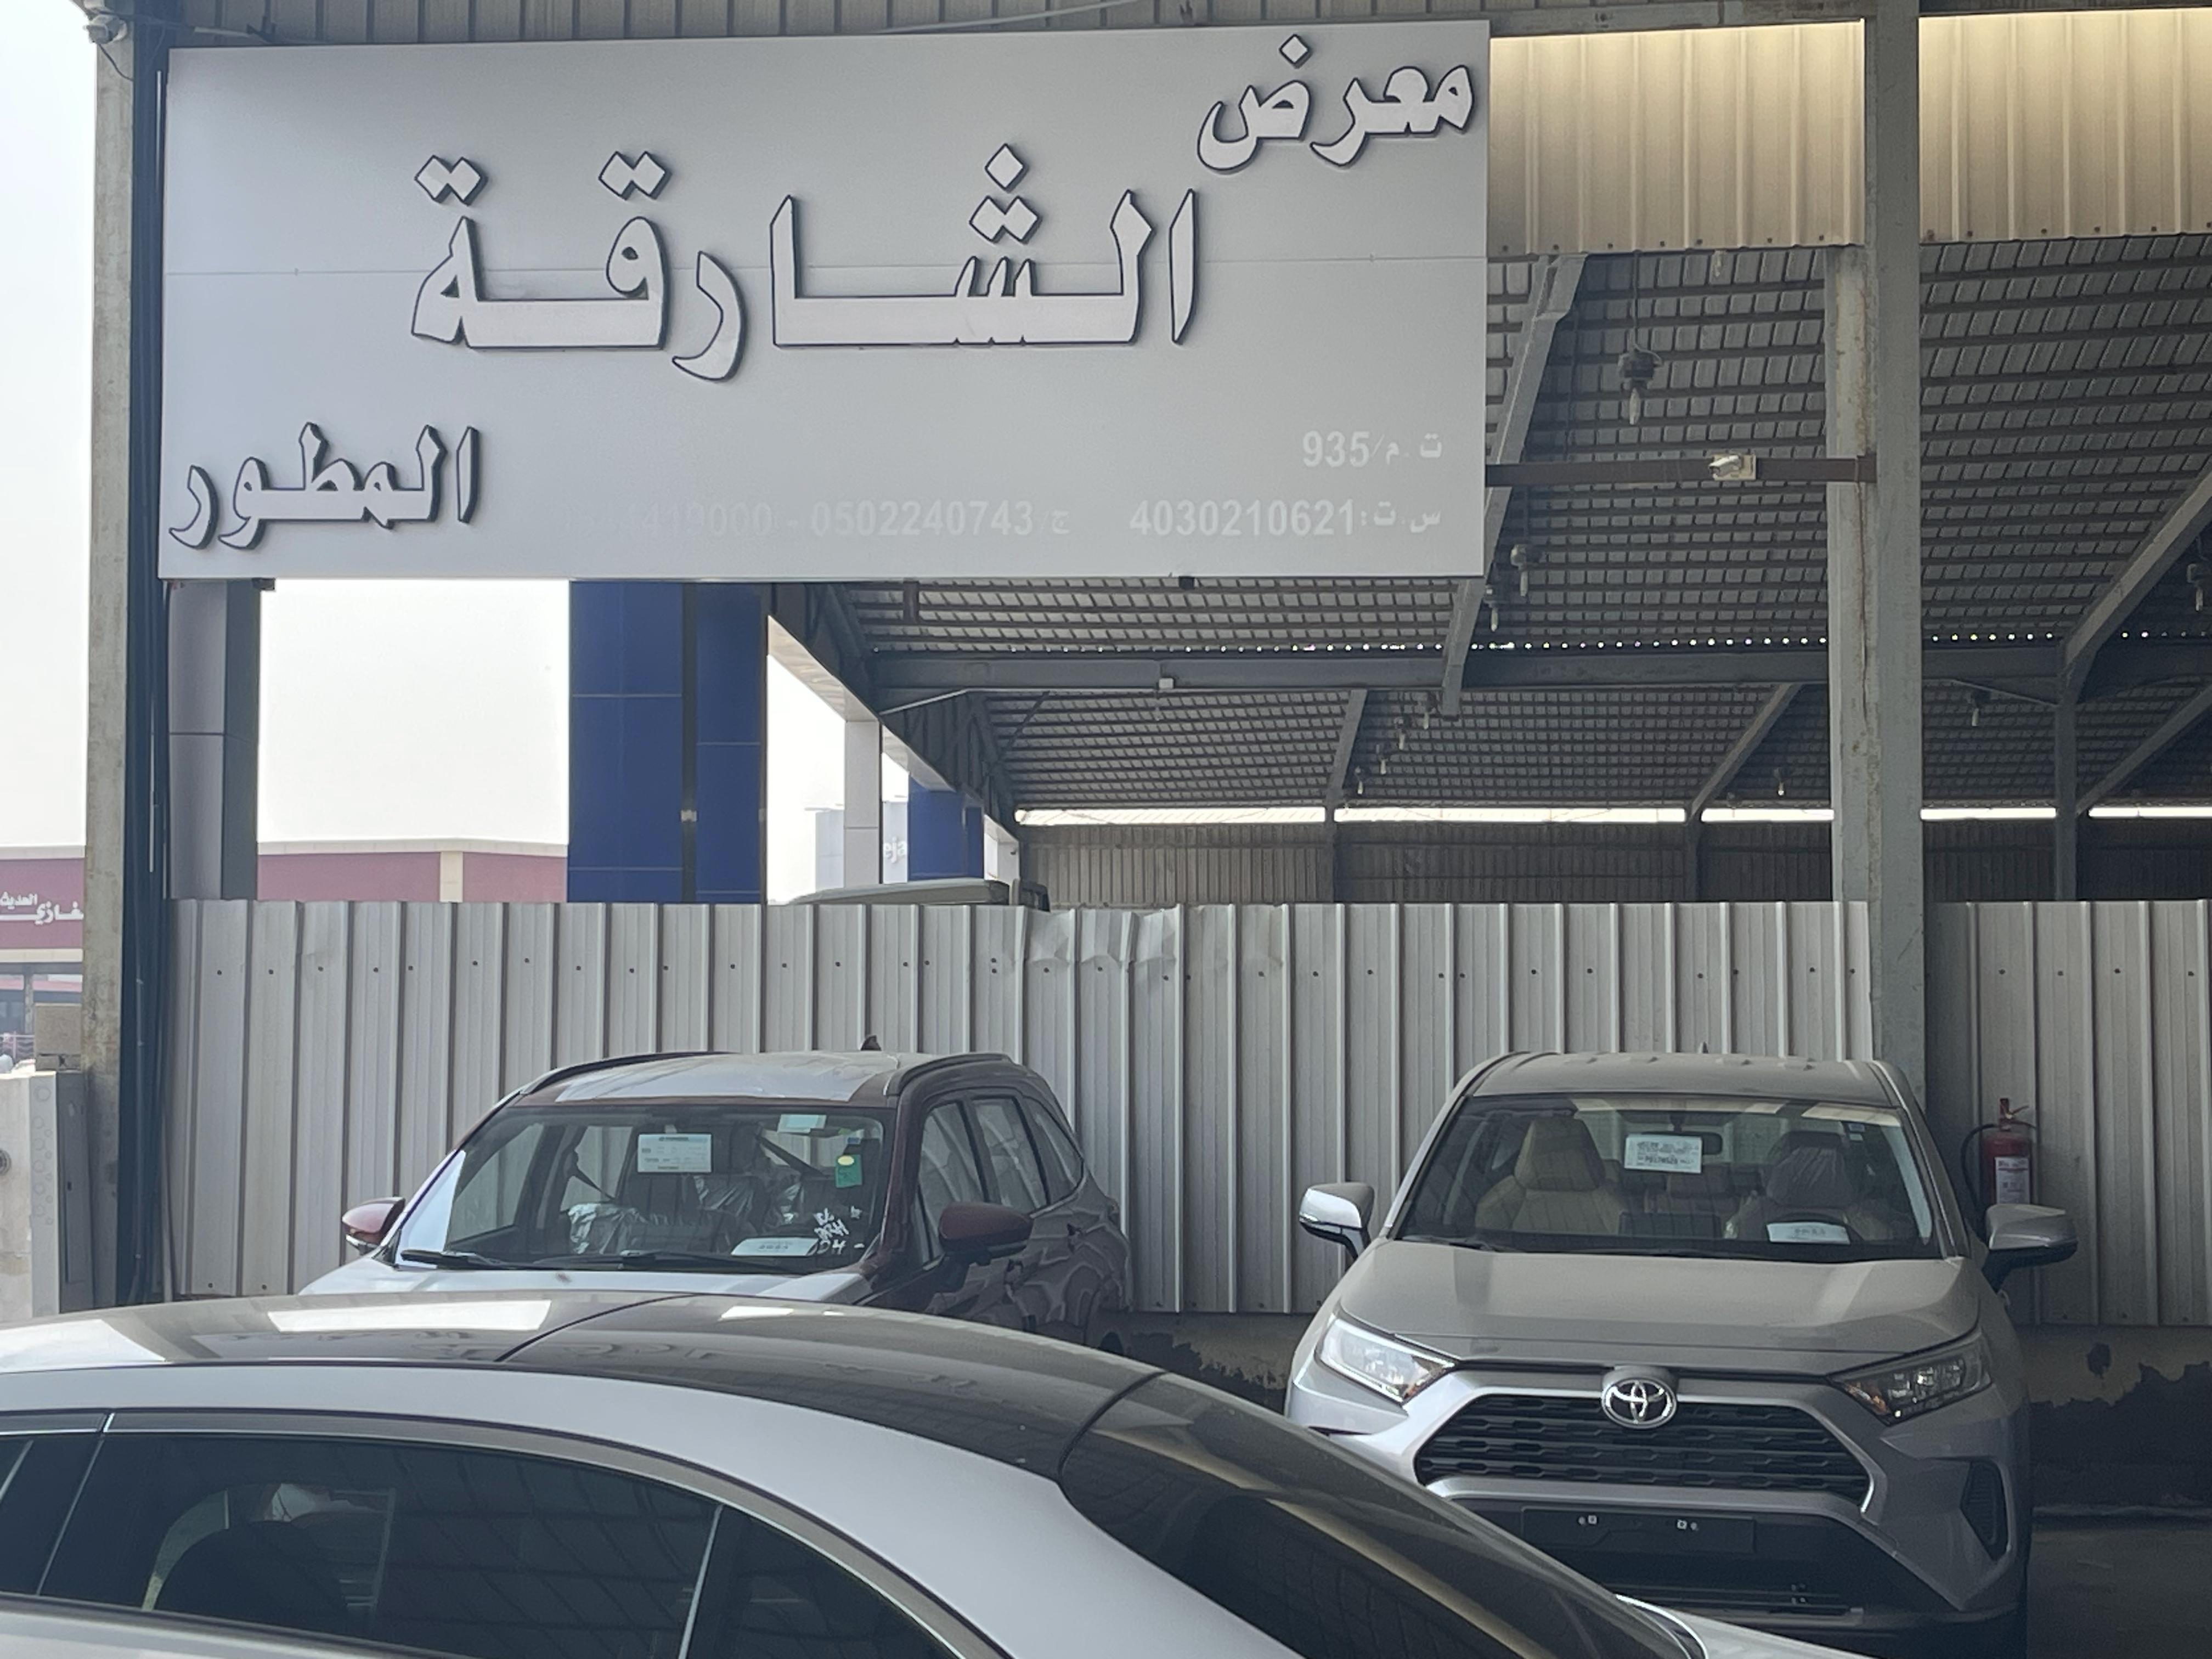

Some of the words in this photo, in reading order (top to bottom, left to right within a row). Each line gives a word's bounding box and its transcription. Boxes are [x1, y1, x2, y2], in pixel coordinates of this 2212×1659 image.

[1197, 35, 1476, 174] معرض
[411, 143, 1200, 382] الشارقة
[169, 421, 479, 550] المطور
